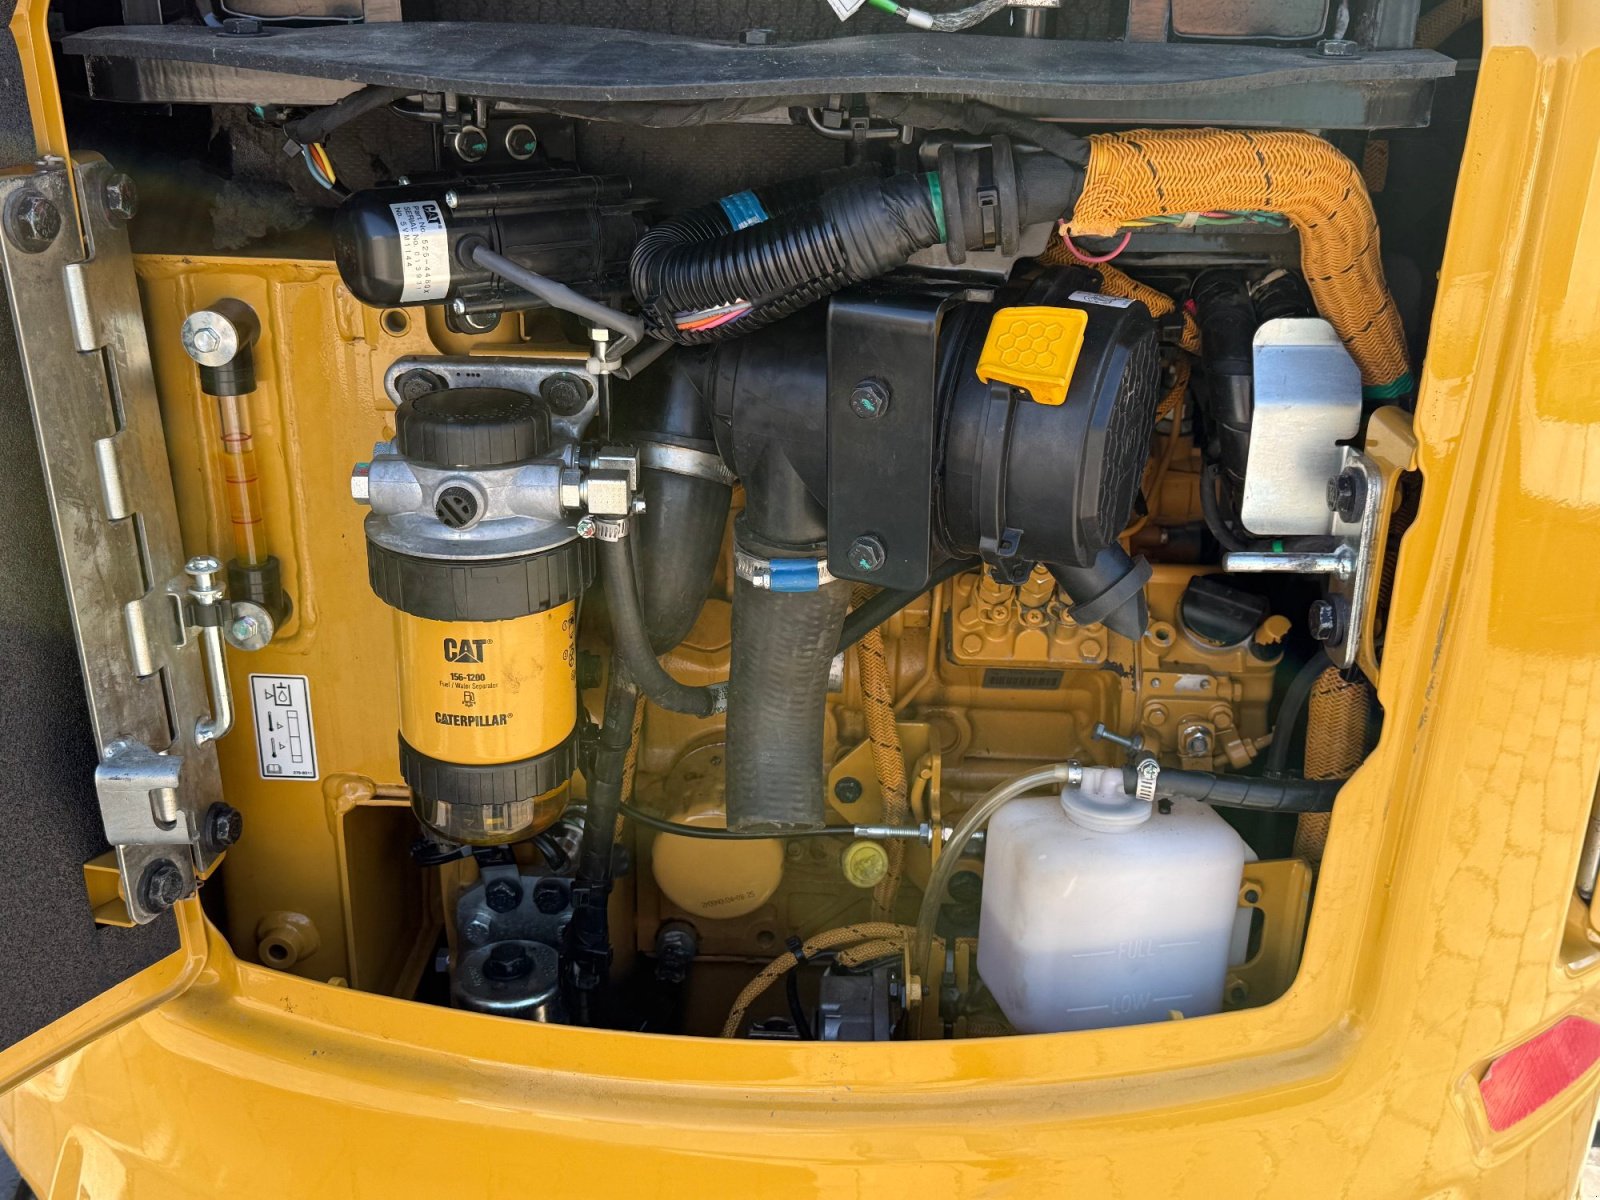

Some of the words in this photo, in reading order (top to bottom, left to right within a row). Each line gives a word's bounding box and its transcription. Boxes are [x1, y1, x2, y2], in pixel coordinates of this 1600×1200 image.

[412, 205, 423, 220] Part
[422, 204, 442, 225] CAT
[403, 206, 417, 232] SERIAL
[412, 234, 420, 248] No.
[443, 637, 487, 663] CAT
[439, 680, 451, 688] Fuel
[450, 672, 486, 681] 156-1200
[435, 712, 507, 727] CATERPILLAR
[1118, 939, 1156, 960] FULL
[1111, 991, 1152, 1015] LOW
